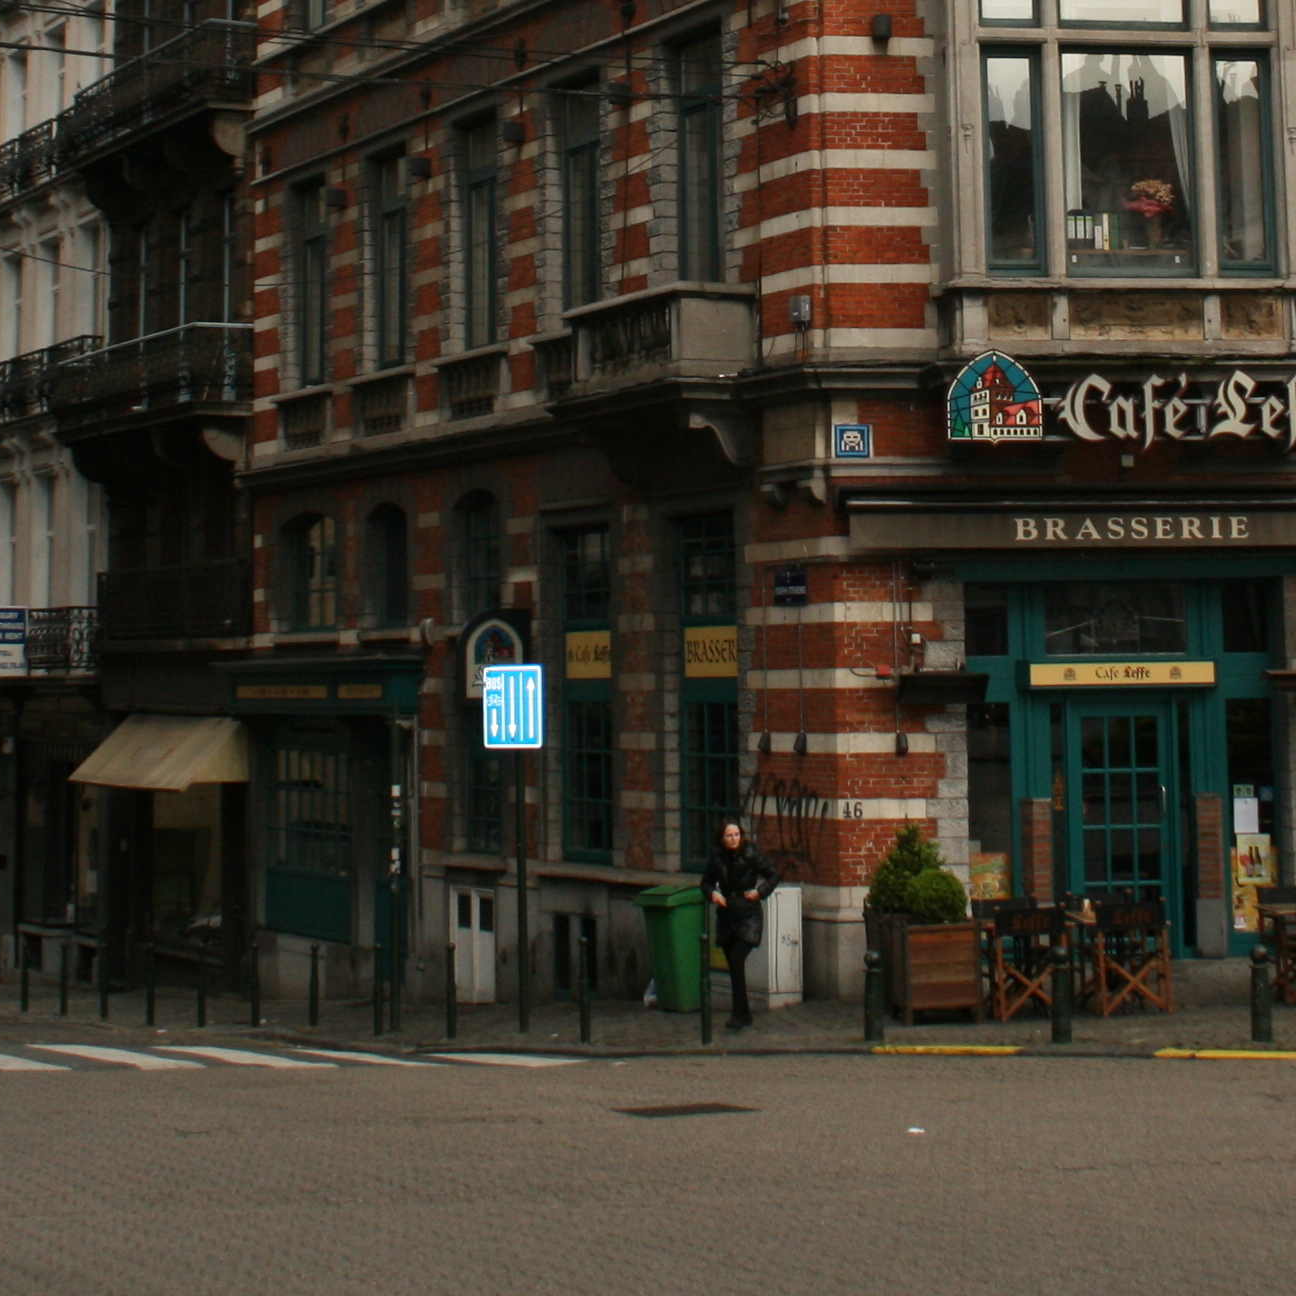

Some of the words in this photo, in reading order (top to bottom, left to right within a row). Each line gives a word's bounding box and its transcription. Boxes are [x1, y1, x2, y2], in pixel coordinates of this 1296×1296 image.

[1053, 371, 1188, 452] Café
[1014, 515, 1250, 541] BRASSERIE
[1123, 664, 1151, 681] Leffe
[485, 676, 502, 691] BUS
[841, 801, 863, 820] 46
[1010, 913, 1052, 931] Leffe
[1112, 907, 1154, 926] Leffe
